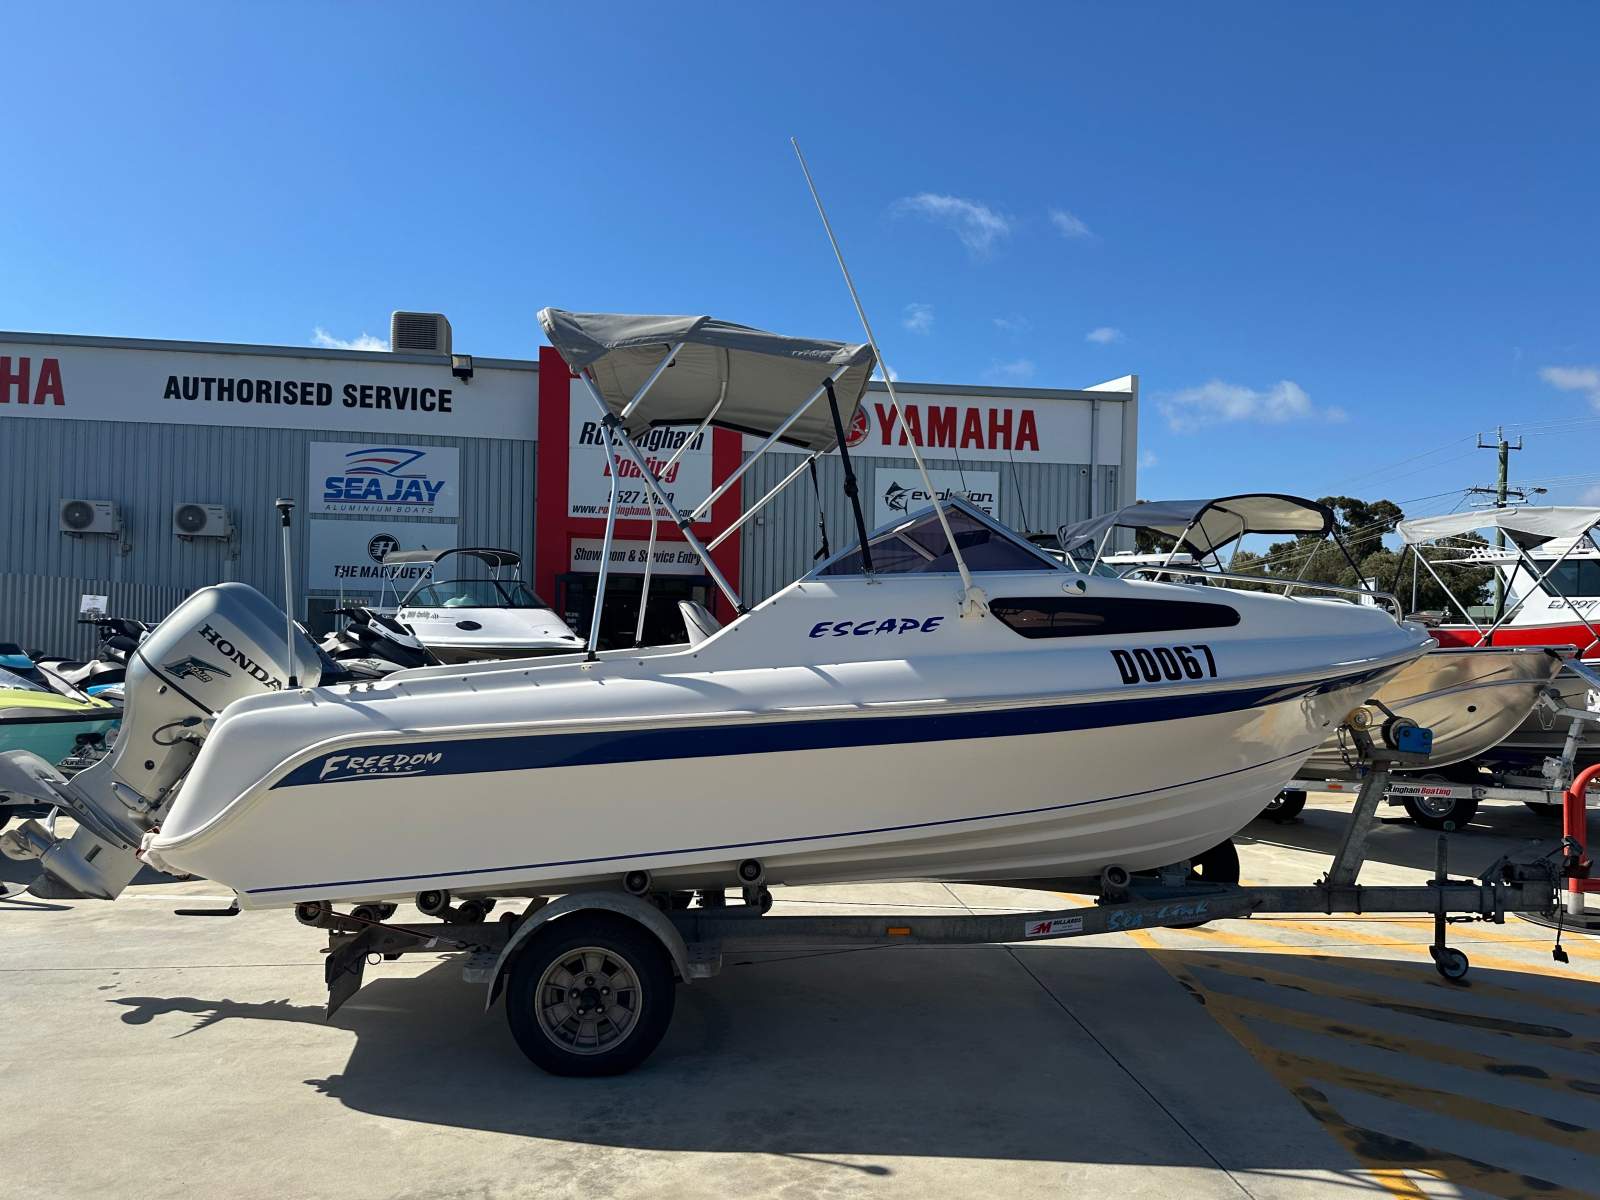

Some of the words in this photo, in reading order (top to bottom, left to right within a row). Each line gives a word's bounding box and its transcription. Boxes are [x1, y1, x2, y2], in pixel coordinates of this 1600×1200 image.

[163, 375, 333, 406] AUTHORISED
[342, 384, 453, 413] SERVICE
[874, 403, 1040, 452] YAMAHA
[323, 476, 384, 500] SEA
[387, 479, 446, 502] JAY
[911, 488, 994, 503] evolion
[324, 504, 393, 513] ALUMINIUM
[396, 506, 435, 514] BOATS
[574, 547, 626, 562] Showom
[628, 549, 636, 562] &
[677, 551, 701, 567] Entry
[334, 565, 359, 578] THE
[808, 616, 945, 638] ESCAPE
[198, 623, 283, 692] HONDA
[319, 752, 443, 781] FREEDOM
[1420, 786, 1452, 797] Boating
